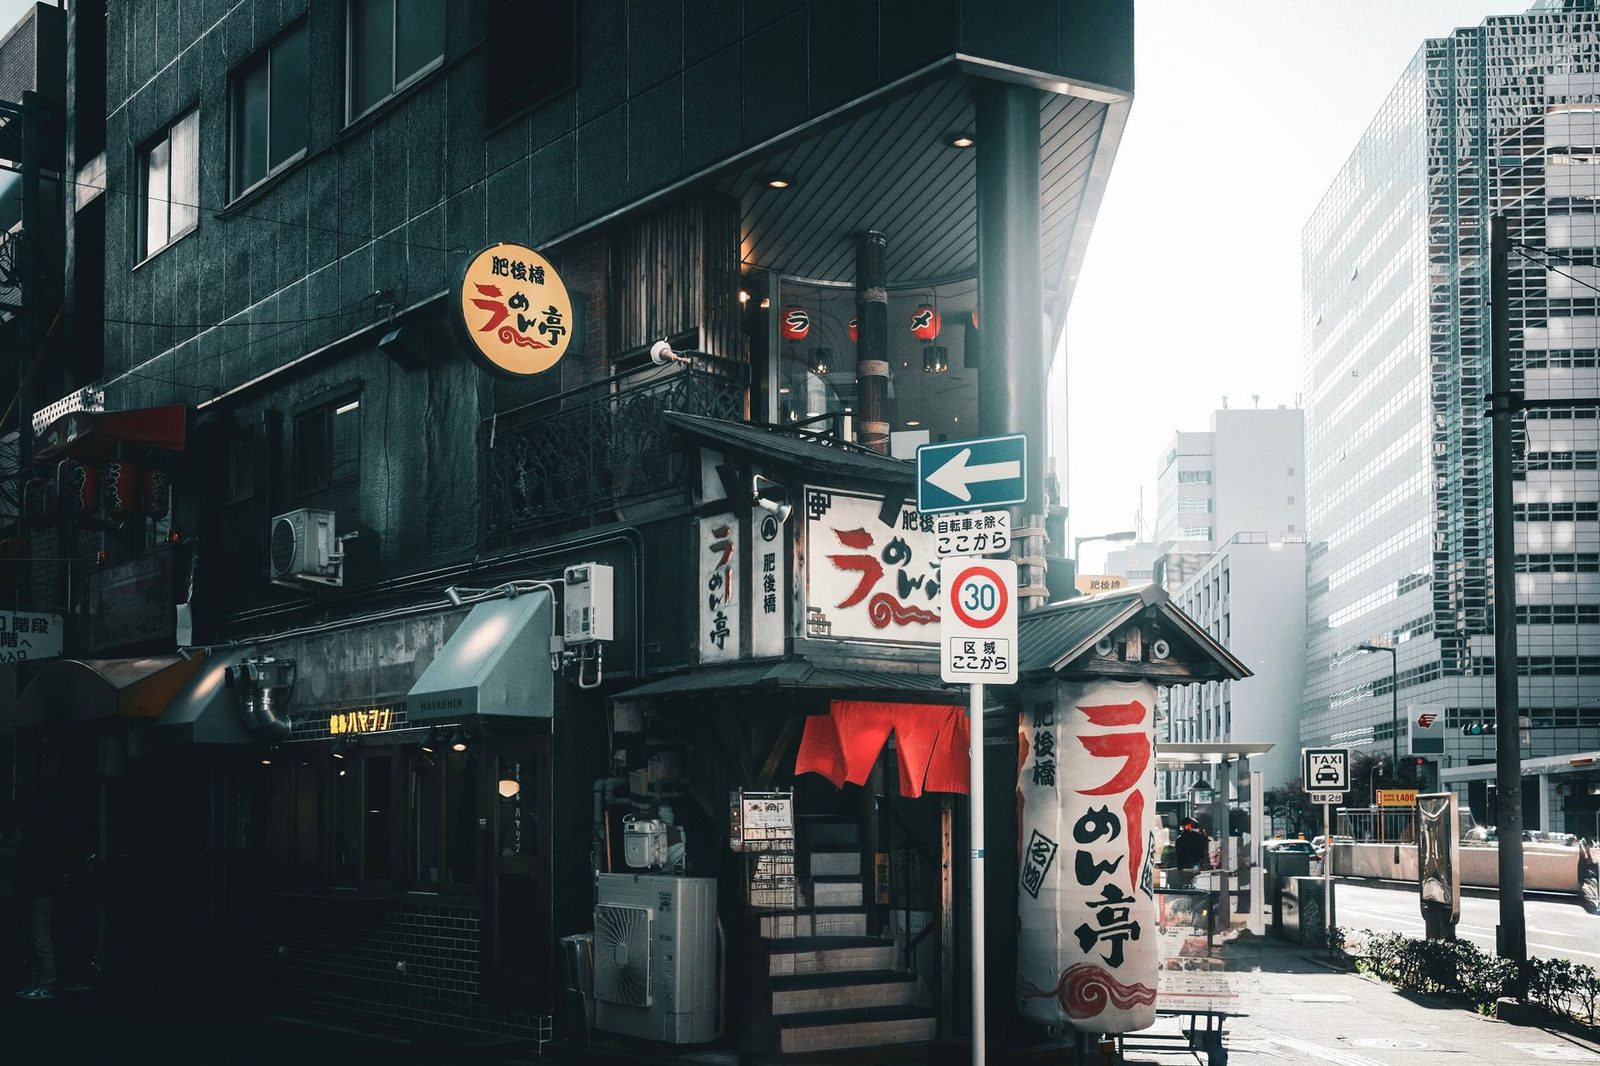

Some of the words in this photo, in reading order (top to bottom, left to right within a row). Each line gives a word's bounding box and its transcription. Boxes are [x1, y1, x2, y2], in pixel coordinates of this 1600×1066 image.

[491, 256, 546, 286] 肥後橋
[786, 310, 810, 332] ラ
[910, 310, 934, 331] メ
[901, 509, 938, 534] 肥後
[938, 515, 1006, 534] 自転車を除く
[937, 531, 1007, 554] ここから
[763, 553, 776, 614] 肥後橋
[964, 583, 996, 612] 30
[964, 641, 996, 655] 区域
[952, 655, 1008, 670] ここから
[420, 698, 463, 711] HAYASHIN
[1031, 701, 1055, 788] 肥後橋
[1312, 755, 1342, 764] TAXI
[1395, 793, 1414, 803] 1,400
